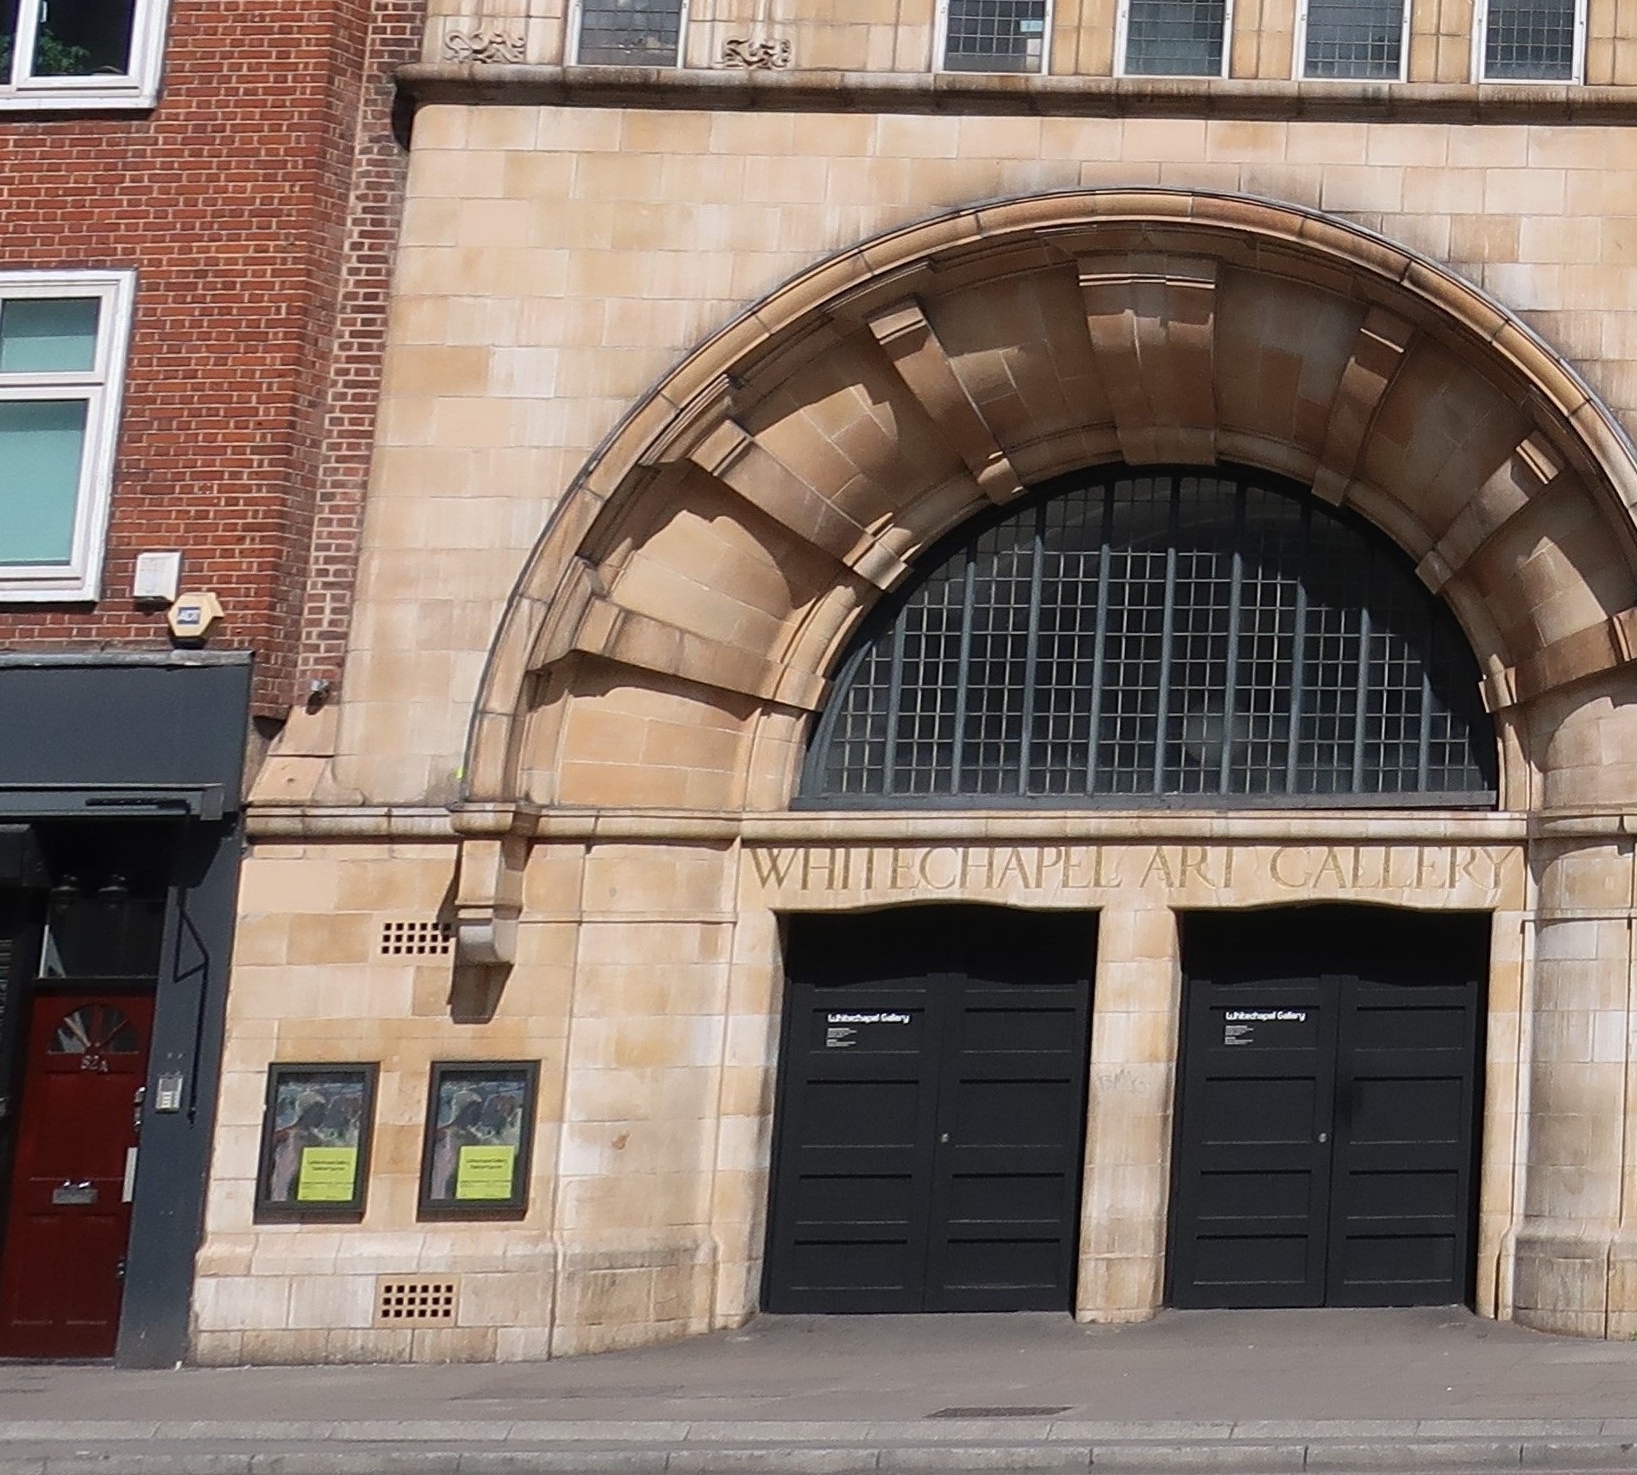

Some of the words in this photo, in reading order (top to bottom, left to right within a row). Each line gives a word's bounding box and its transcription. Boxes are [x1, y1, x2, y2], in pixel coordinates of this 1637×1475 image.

[749, 846, 1123, 891] WHITECHAPEL
[1139, 845, 1236, 889] ART
[1269, 845, 1520, 890] GALLERY
